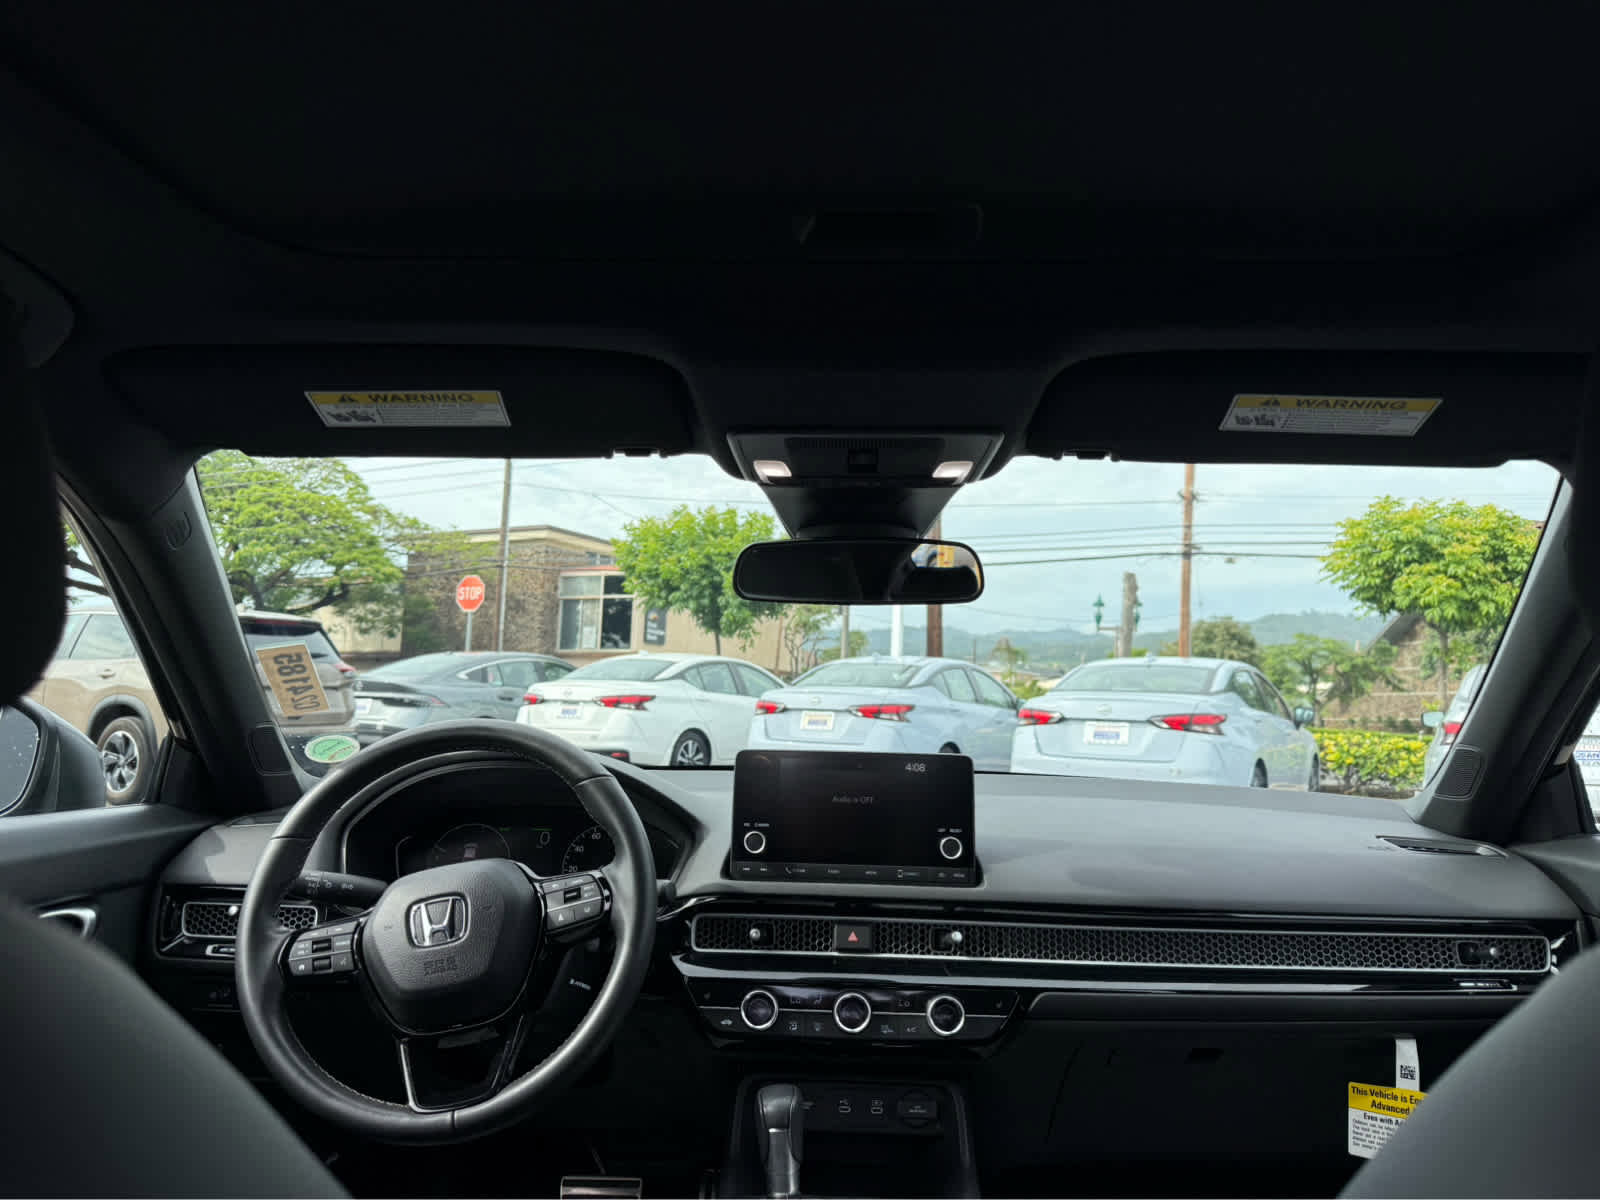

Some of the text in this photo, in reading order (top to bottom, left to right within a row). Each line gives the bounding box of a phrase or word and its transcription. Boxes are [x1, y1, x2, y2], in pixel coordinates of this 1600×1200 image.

[368, 393, 474, 404] WARNING
[1296, 399, 1408, 410] WARNING
[457, 586, 482, 600] STOP
[905, 763, 926, 773] 4:08
[1351, 1086, 1368, 1096] This
[1369, 1088, 1398, 1101] Vehicle
[1401, 1095, 1407, 1103] is
[1371, 1100, 1410, 1115] Advanced
[1363, 1113, 1378, 1122] Even
[1380, 1117, 1393, 1125] with
